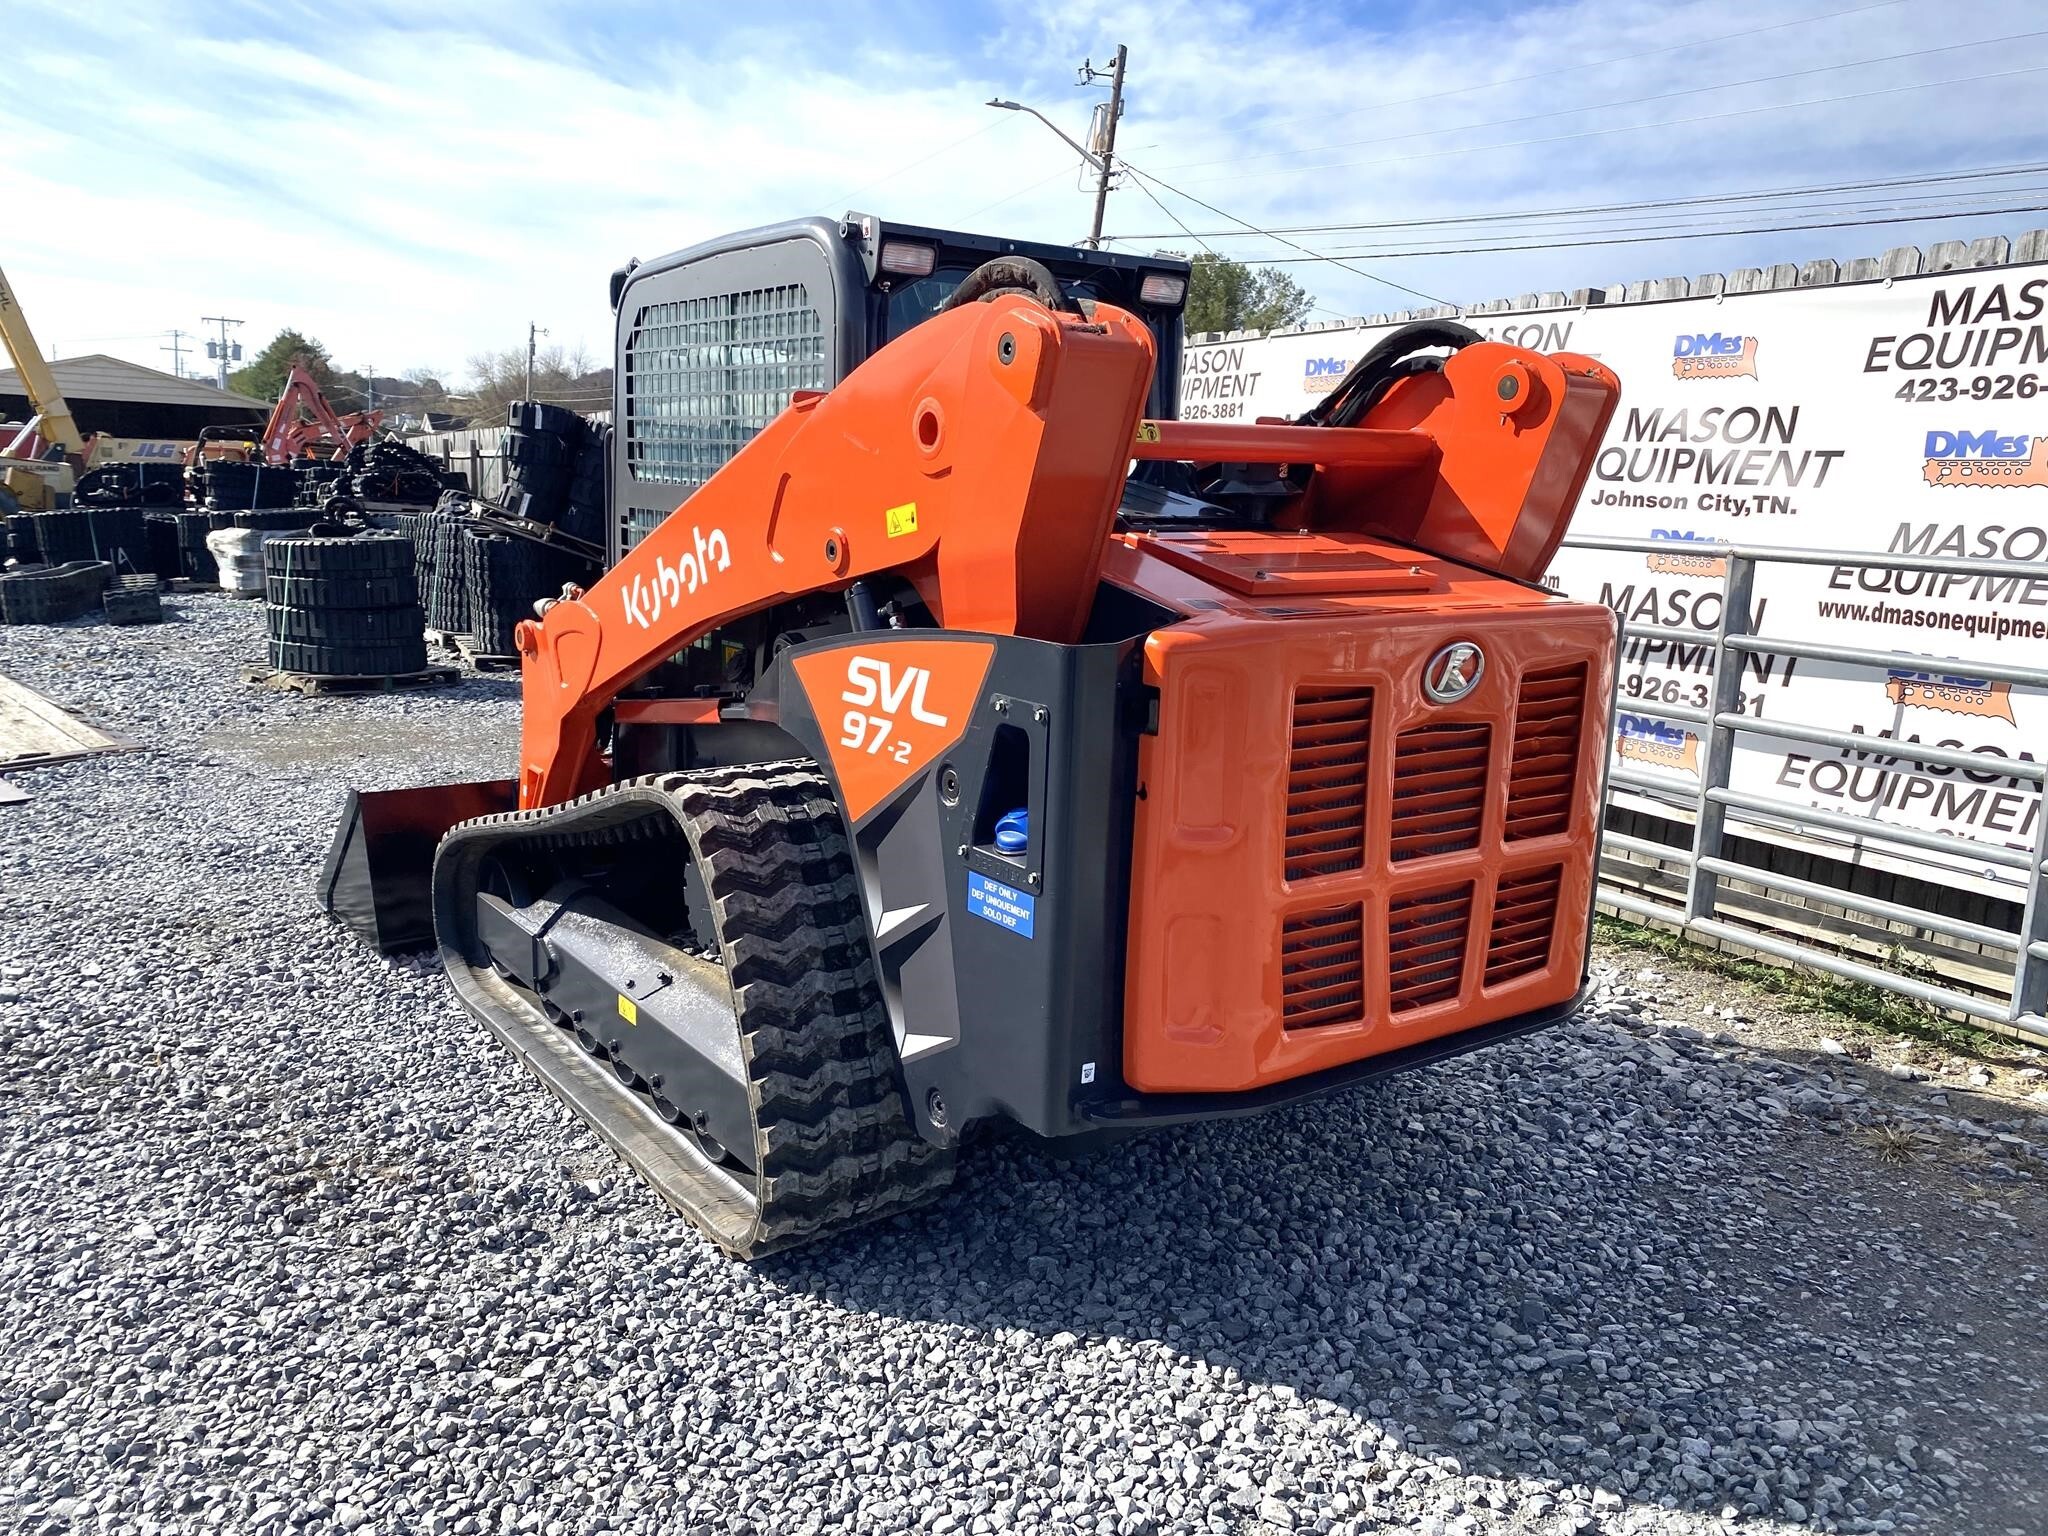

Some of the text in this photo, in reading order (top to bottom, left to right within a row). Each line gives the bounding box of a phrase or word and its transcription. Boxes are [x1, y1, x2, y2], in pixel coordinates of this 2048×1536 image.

[1181, 372, 1261, 401] IPMENT
[1622, 405, 1800, 445] MASON
[131, 443, 176, 458] JLG
[1590, 489, 1798, 517] Johnson City,TN.
[1887, 522, 2048, 562] MASO
[621, 525, 731, 629] Kubota
[1818, 600, 2048, 641] www.dmasonequipme
[841, 655, 948, 728] SVL
[840, 710, 912, 765] 97-2
[971, 888, 1030, 921] DEF UNIQUEMENT
[984, 880, 1017, 902] DEF ONLY
[983, 906, 1017, 928] SOLO DEF
